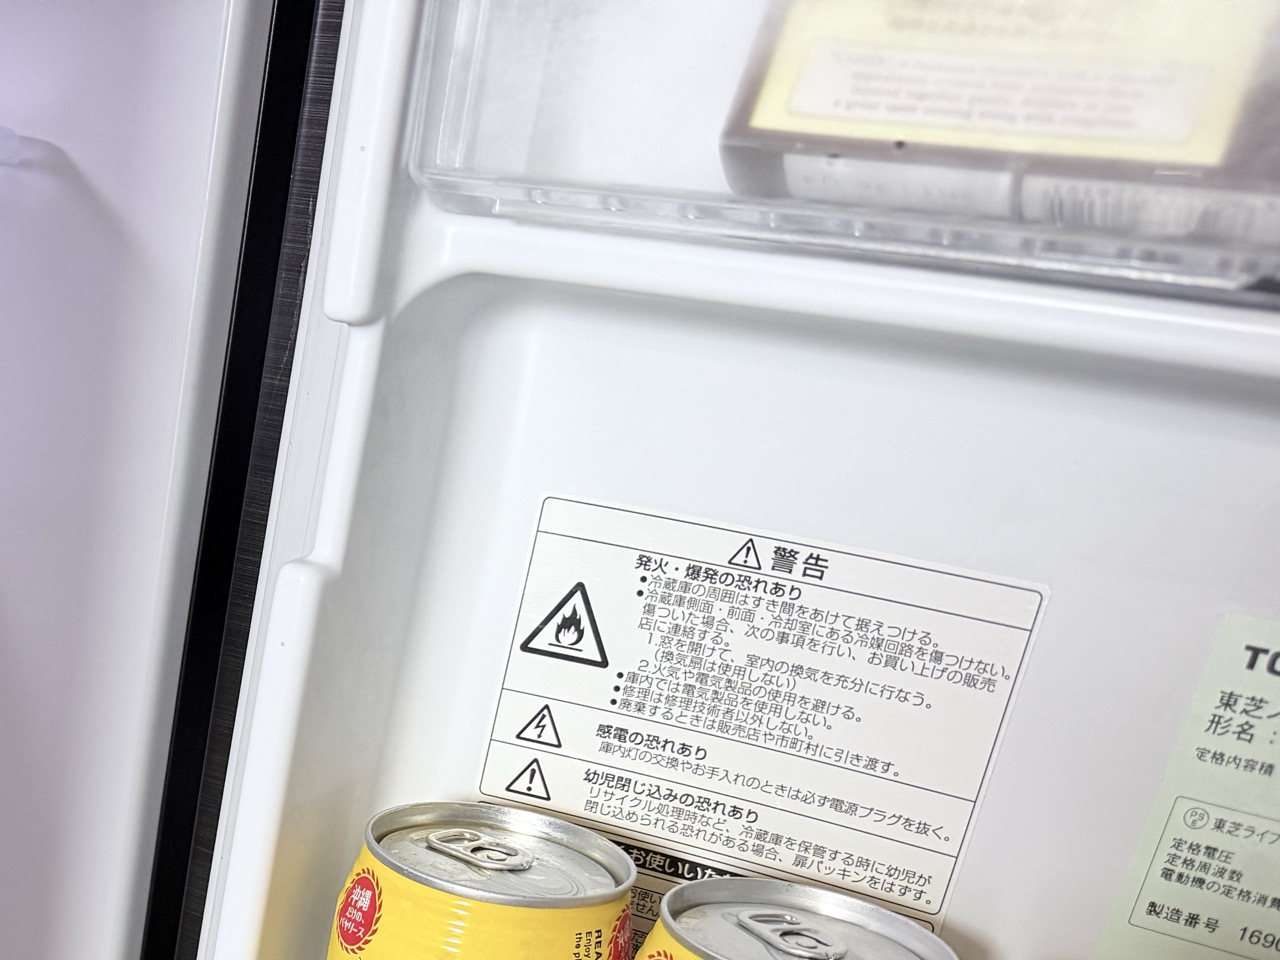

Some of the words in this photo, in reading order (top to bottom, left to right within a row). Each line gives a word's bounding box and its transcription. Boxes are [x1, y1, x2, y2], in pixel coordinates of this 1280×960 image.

[634, 554, 802, 600] 発火・爆発の恐れあり
[771, 545, 829, 581] 警告
[1214, 690, 1280, 719] 東芝
[595, 723, 708, 761] 感電の恐れあり
[1195, 747, 1275, 777] 定格内容積
[583, 768, 759, 823] 幼児閉じ込みの恐れあり
[1169, 837, 1236, 865] 定格電圧
[1163, 852, 1244, 884] 定格周波数
[348, 884, 372, 911] 沖縄
[340, 916, 365, 938] バヤリース
[1145, 901, 1220, 934] 製造番号
[574, 932, 582, 949] the
[583, 931, 593, 959] Enjoy
